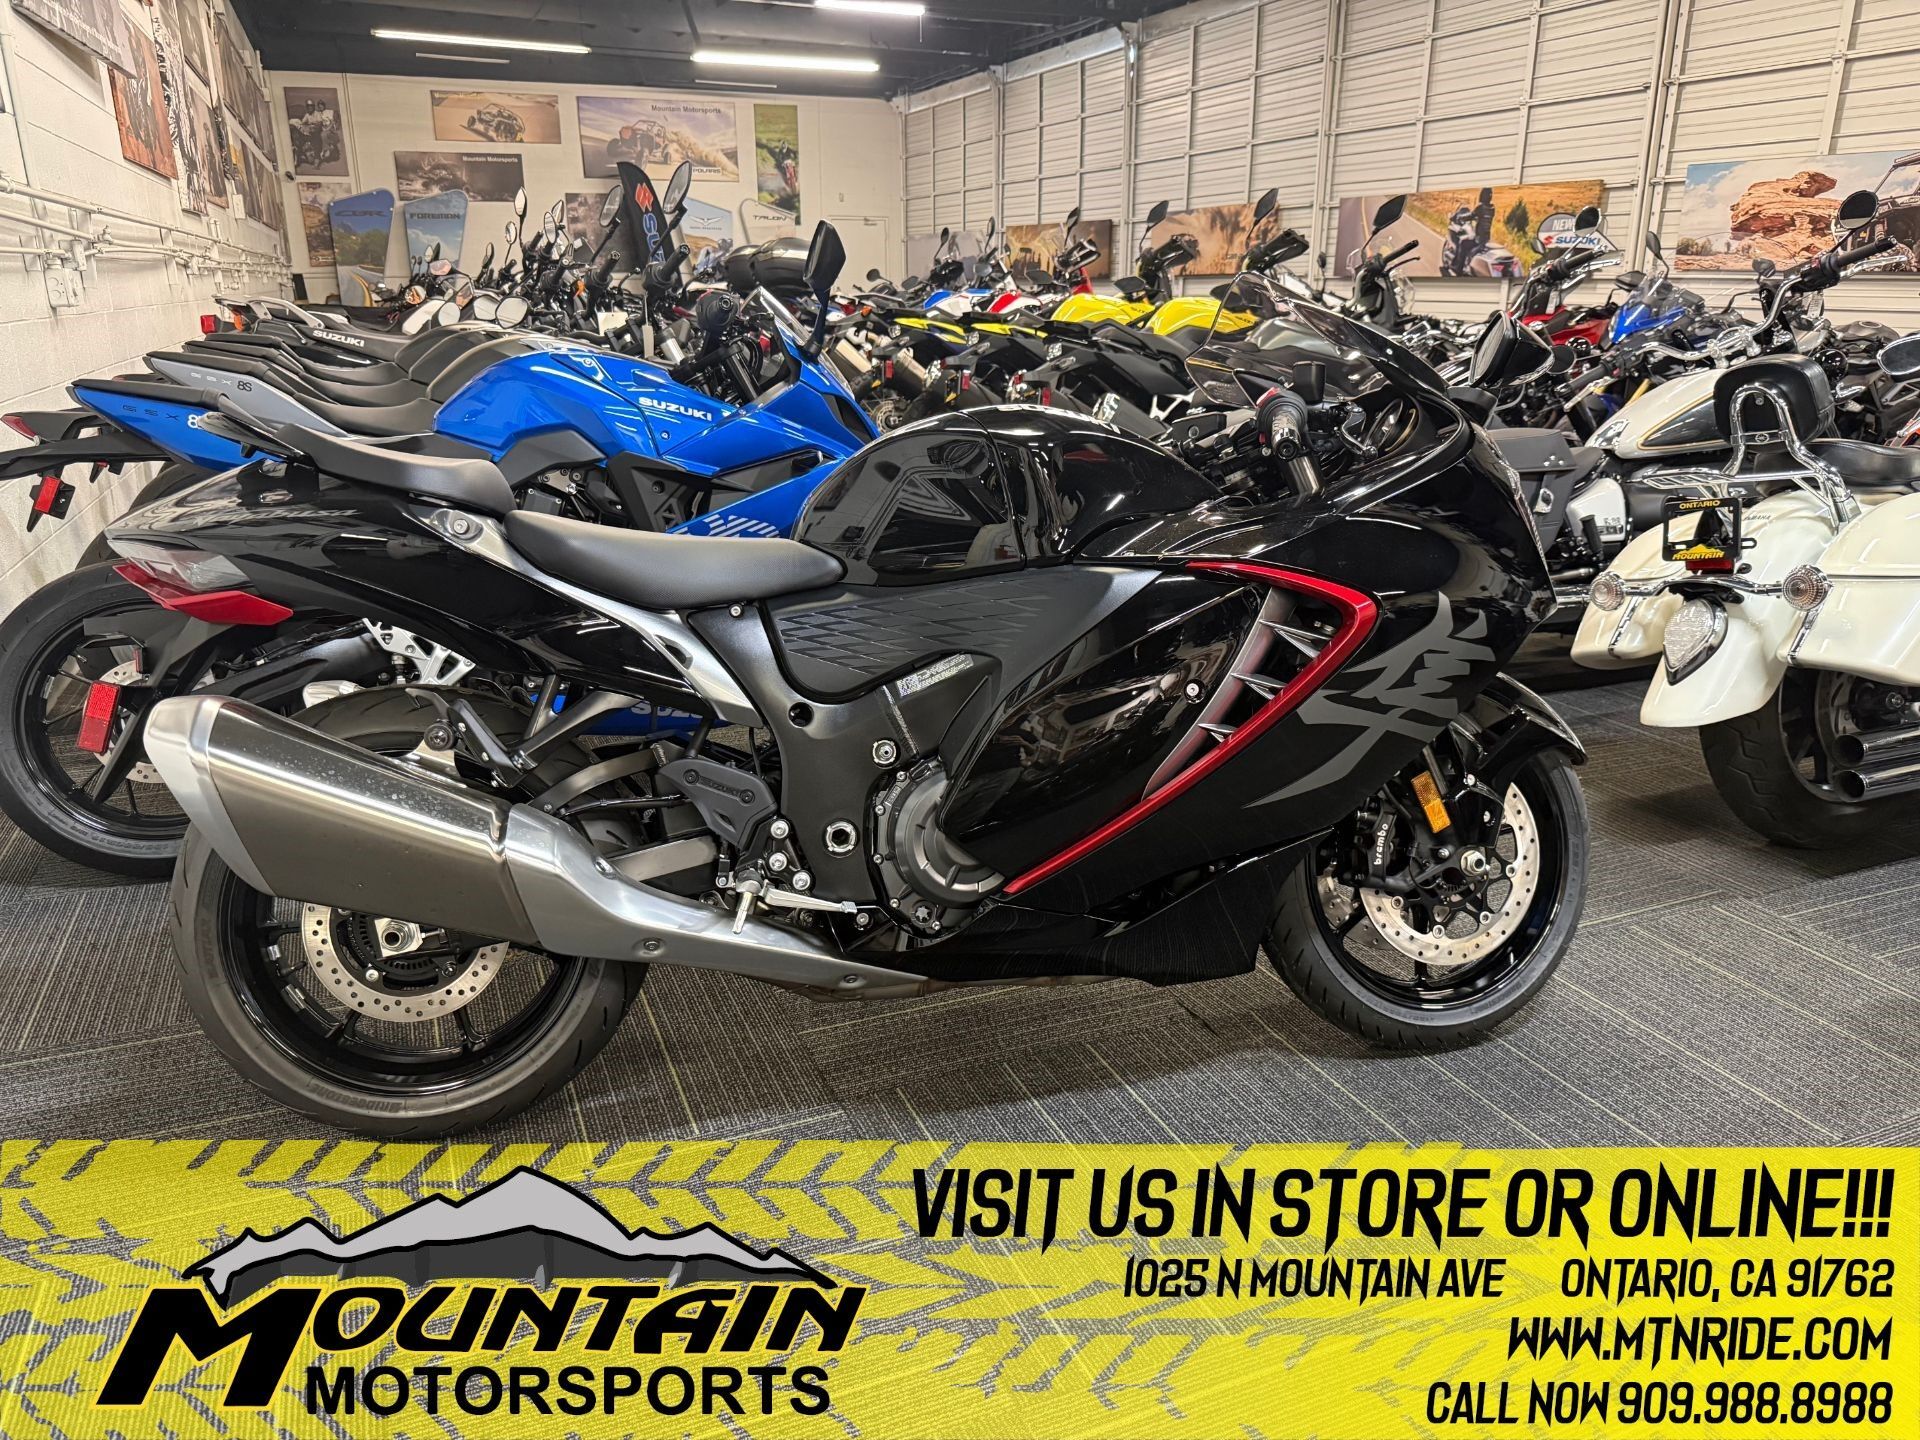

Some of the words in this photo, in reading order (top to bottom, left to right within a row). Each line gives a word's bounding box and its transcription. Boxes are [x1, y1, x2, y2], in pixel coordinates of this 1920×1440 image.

[651, 104, 681, 112] Mountain
[682, 106, 722, 114] Motorsports
[312, 329, 365, 348] SUZUKI
[237, 380, 253, 392] 8S
[638, 396, 713, 422] SUZUKI
[1679, 500, 1721, 510] ONTARIO
[1671, 551, 1725, 561] MOUNTAIN
[1373, 823, 1389, 866] brembo
